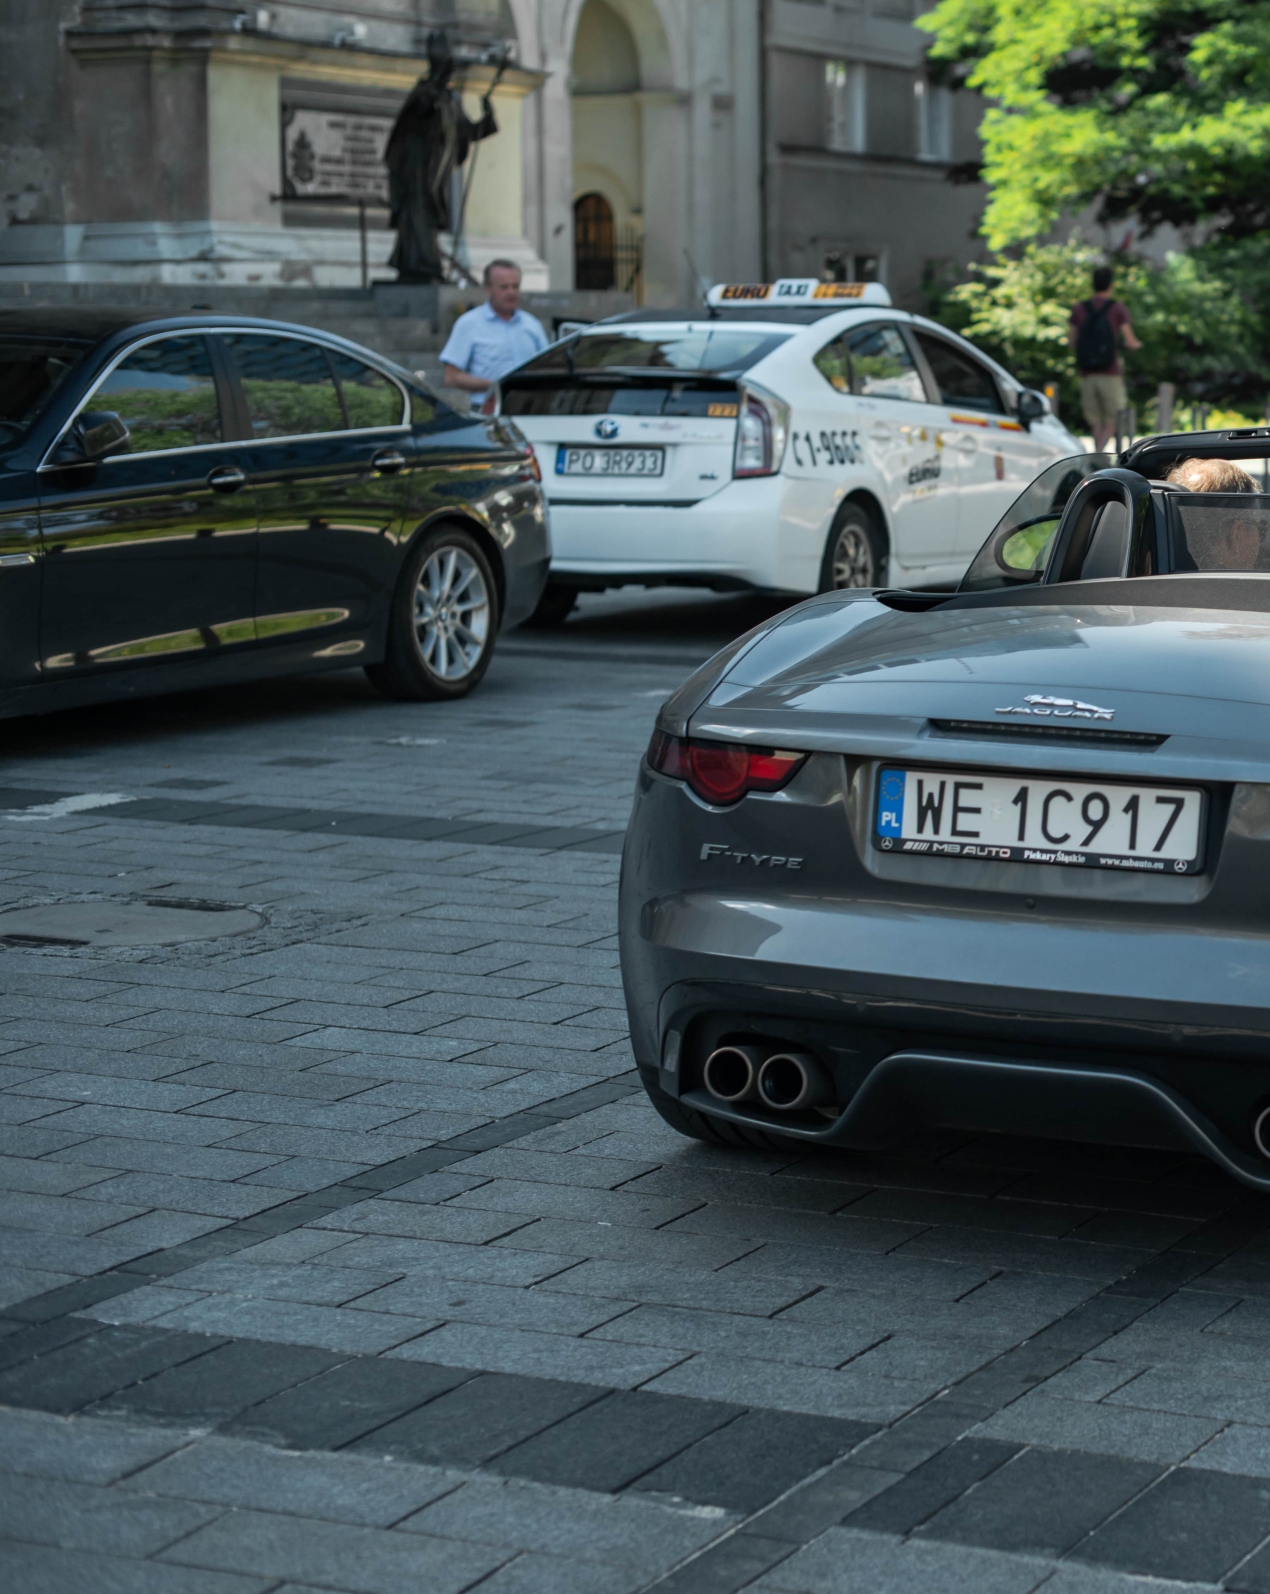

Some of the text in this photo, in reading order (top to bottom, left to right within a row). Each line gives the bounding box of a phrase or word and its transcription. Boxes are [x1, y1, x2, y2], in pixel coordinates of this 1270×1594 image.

[720, 284, 769, 300] EURO
[776, 283, 809, 297] TAXI
[567, 452, 659, 472] PO 3R933
[995, 706, 1114, 721] JAGUAR
[881, 811, 900, 828] PL
[916, 778, 1186, 853] WE 1C917
[700, 843, 804, 869] F-TYPE
[932, 842, 1011, 858] MB AUTO
[1023, 850, 1086, 864] Piekary Śląskie
[1099, 856, 1165, 870] www.mbauto.eu
